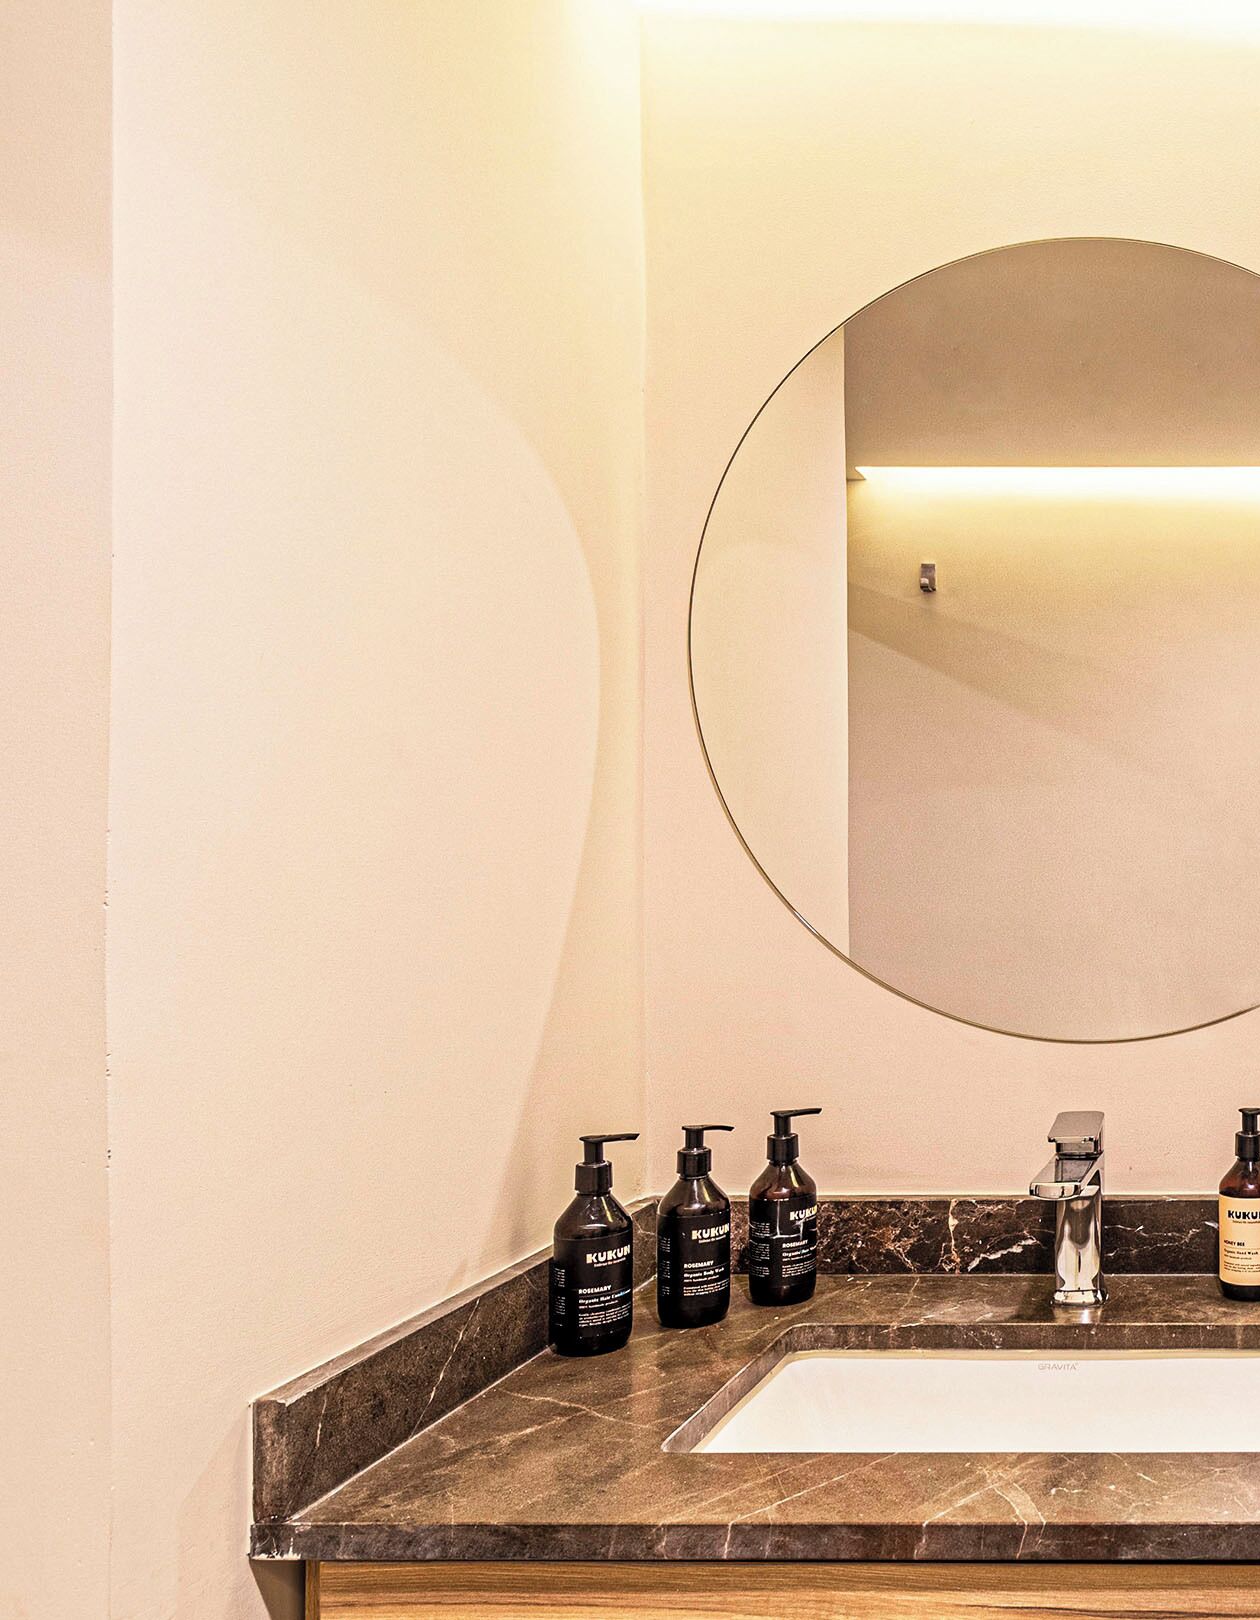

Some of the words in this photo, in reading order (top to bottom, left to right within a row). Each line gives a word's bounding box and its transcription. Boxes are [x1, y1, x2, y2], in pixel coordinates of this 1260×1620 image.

[782, 1240, 808, 1248] ROSEMARY
[586, 1244, 631, 1264] KUKUN
[578, 1285, 612, 1294] ROSEMARY
[1037, 1363, 1077, 1371] GRAVITA
